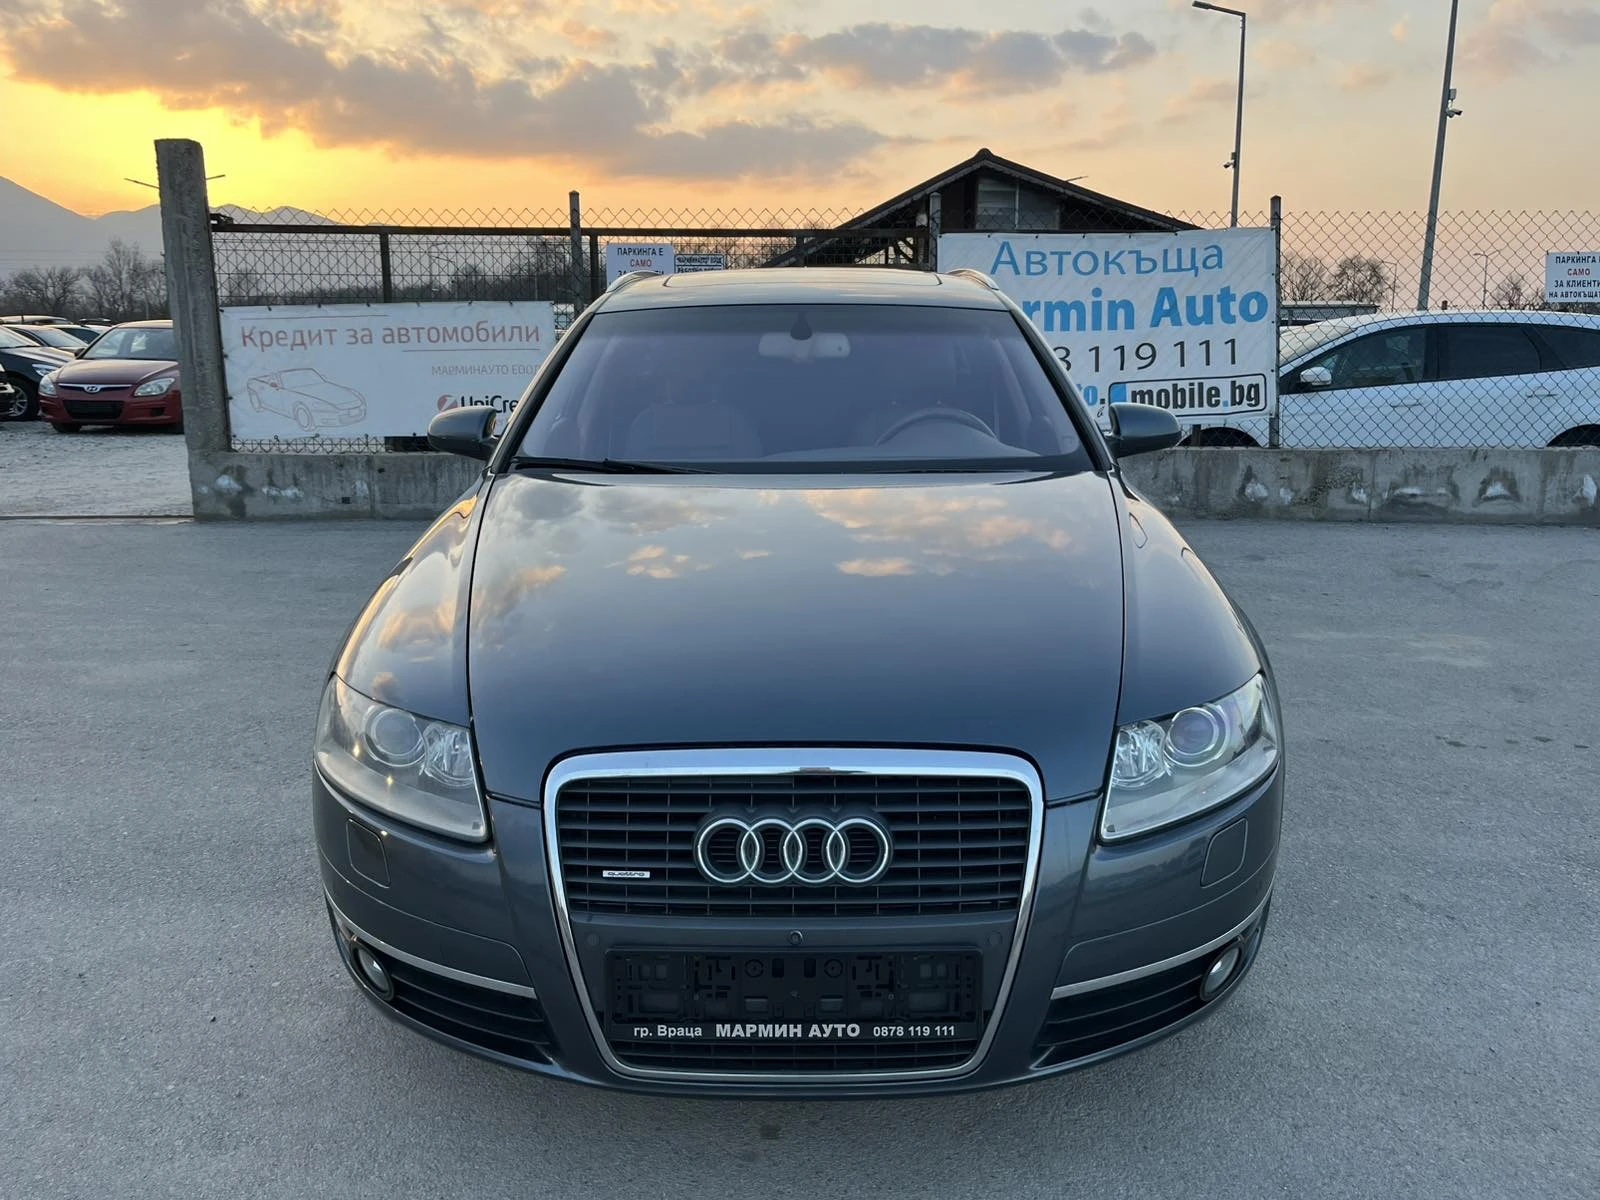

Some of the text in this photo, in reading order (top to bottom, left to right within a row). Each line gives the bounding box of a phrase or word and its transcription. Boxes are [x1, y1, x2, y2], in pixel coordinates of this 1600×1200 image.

[617, 247, 664, 256] ПАРКИНГА Е
[990, 240, 1224, 277] Автокъща
[630, 259, 653, 267] САМО
[1555, 255, 1597, 264] ПАРКИНГА
[1567, 268, 1591, 276] САМО
[1554, 279, 1564, 288] ЗА
[1022, 285, 1269, 332] rmin Auto
[241, 320, 540, 352] Кредит за автомобили
[1088, 342, 1157, 373] 119
[1173, 339, 1236, 367] 111
[1130, 380, 1260, 410] mobile.bg
[634, 1024, 955, 1038] гр. Враца МАРМИН АУТО 0878 119 111
